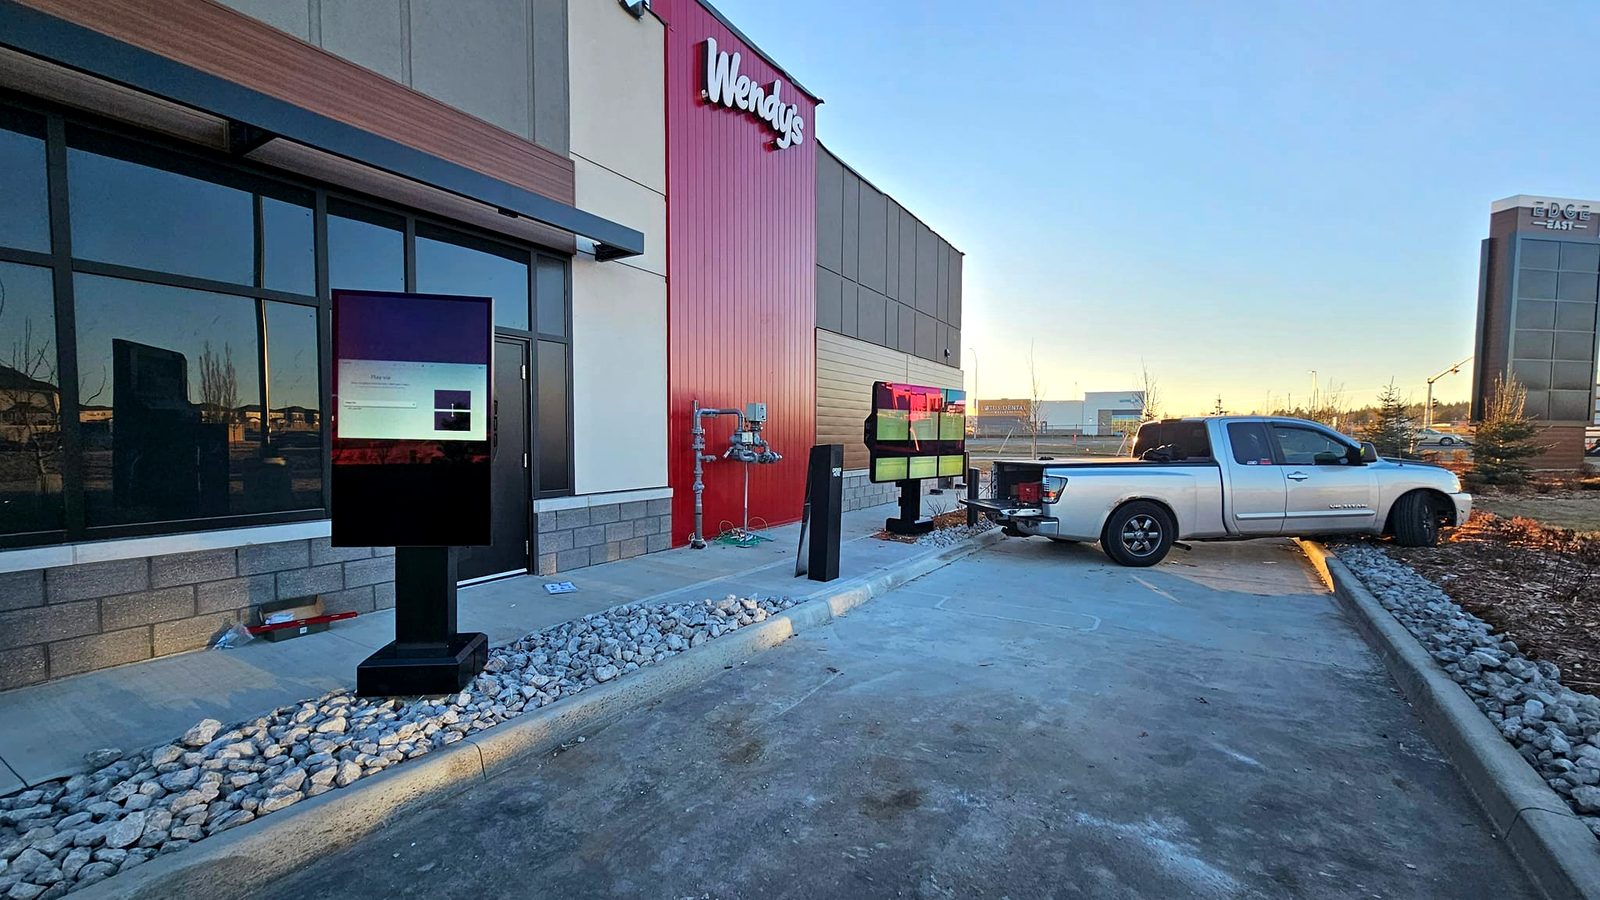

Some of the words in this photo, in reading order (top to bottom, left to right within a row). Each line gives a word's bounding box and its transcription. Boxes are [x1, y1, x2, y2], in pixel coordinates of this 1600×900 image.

[706, 37, 804, 149] Wendy's
[1534, 201, 1590, 220] EDGE
[1547, 220, 1574, 230] EAST
